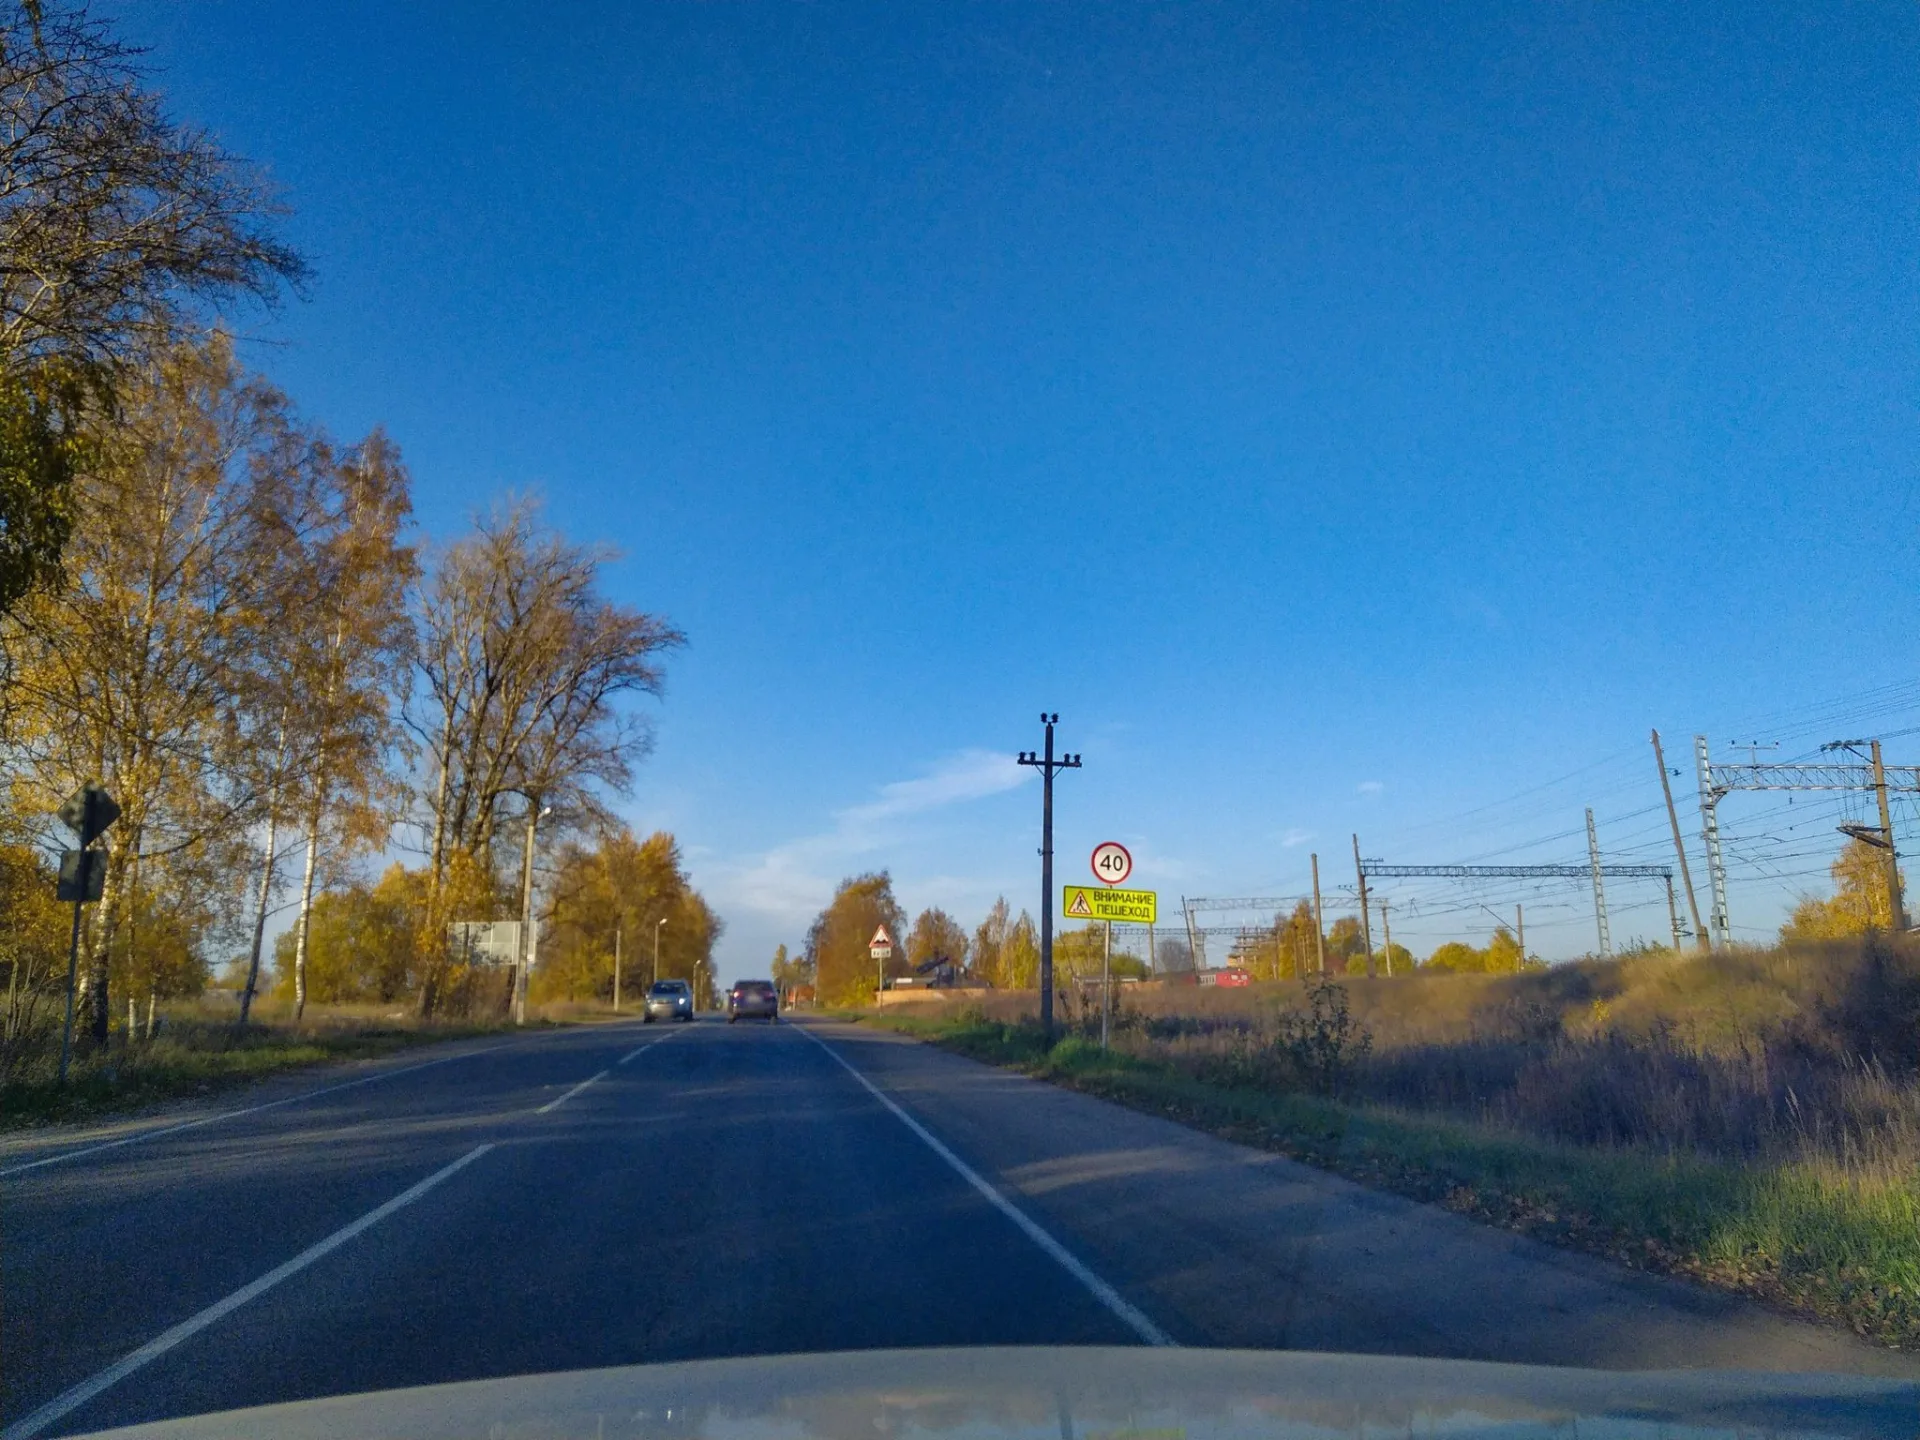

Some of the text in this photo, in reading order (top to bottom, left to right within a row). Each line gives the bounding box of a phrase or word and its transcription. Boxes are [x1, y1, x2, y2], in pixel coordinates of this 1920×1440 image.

[1100, 855, 1123, 871] 40
[1093, 891, 1153, 905] ВНИМАНИЕ
[1096, 904, 1150, 918] ПЕШЕХОД
